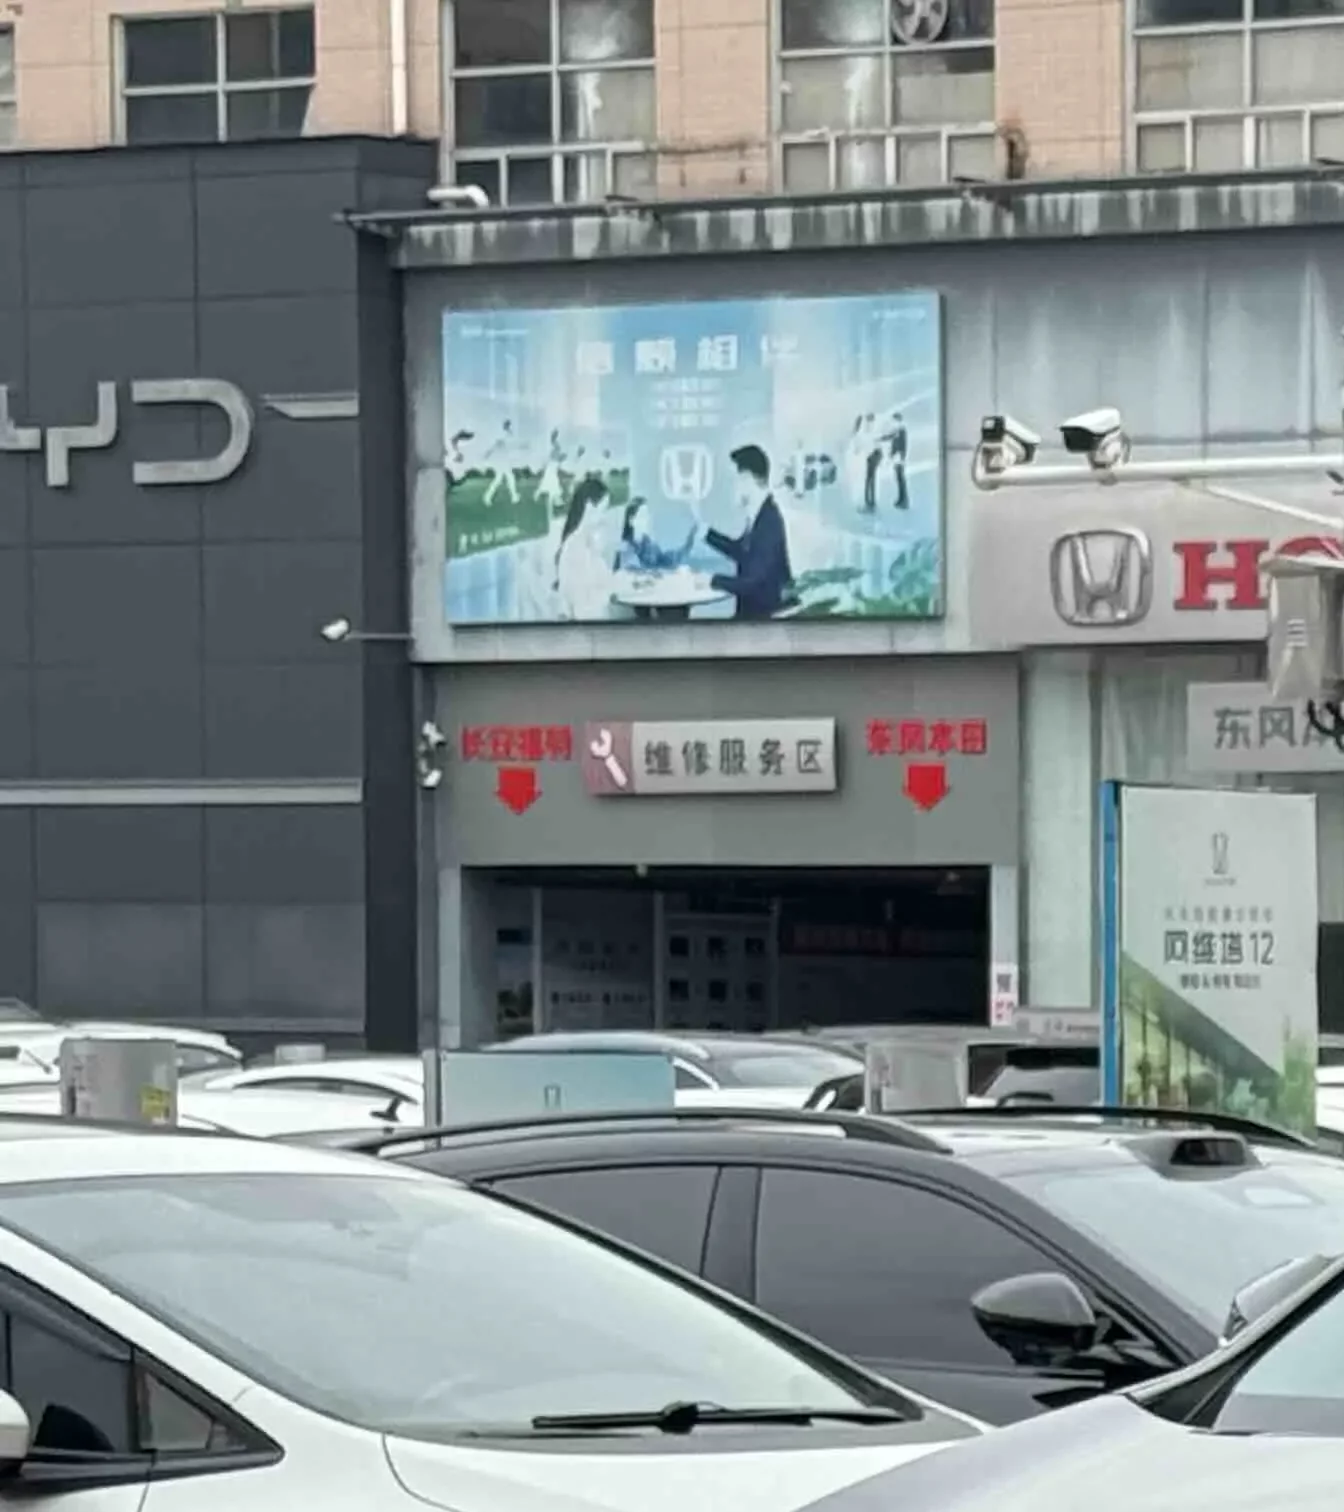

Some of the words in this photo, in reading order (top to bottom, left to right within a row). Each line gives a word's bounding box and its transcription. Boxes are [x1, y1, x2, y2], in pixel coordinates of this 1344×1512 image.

[865, 717, 988, 756] 东风本田
[643, 738, 825, 777] 维修服务区
